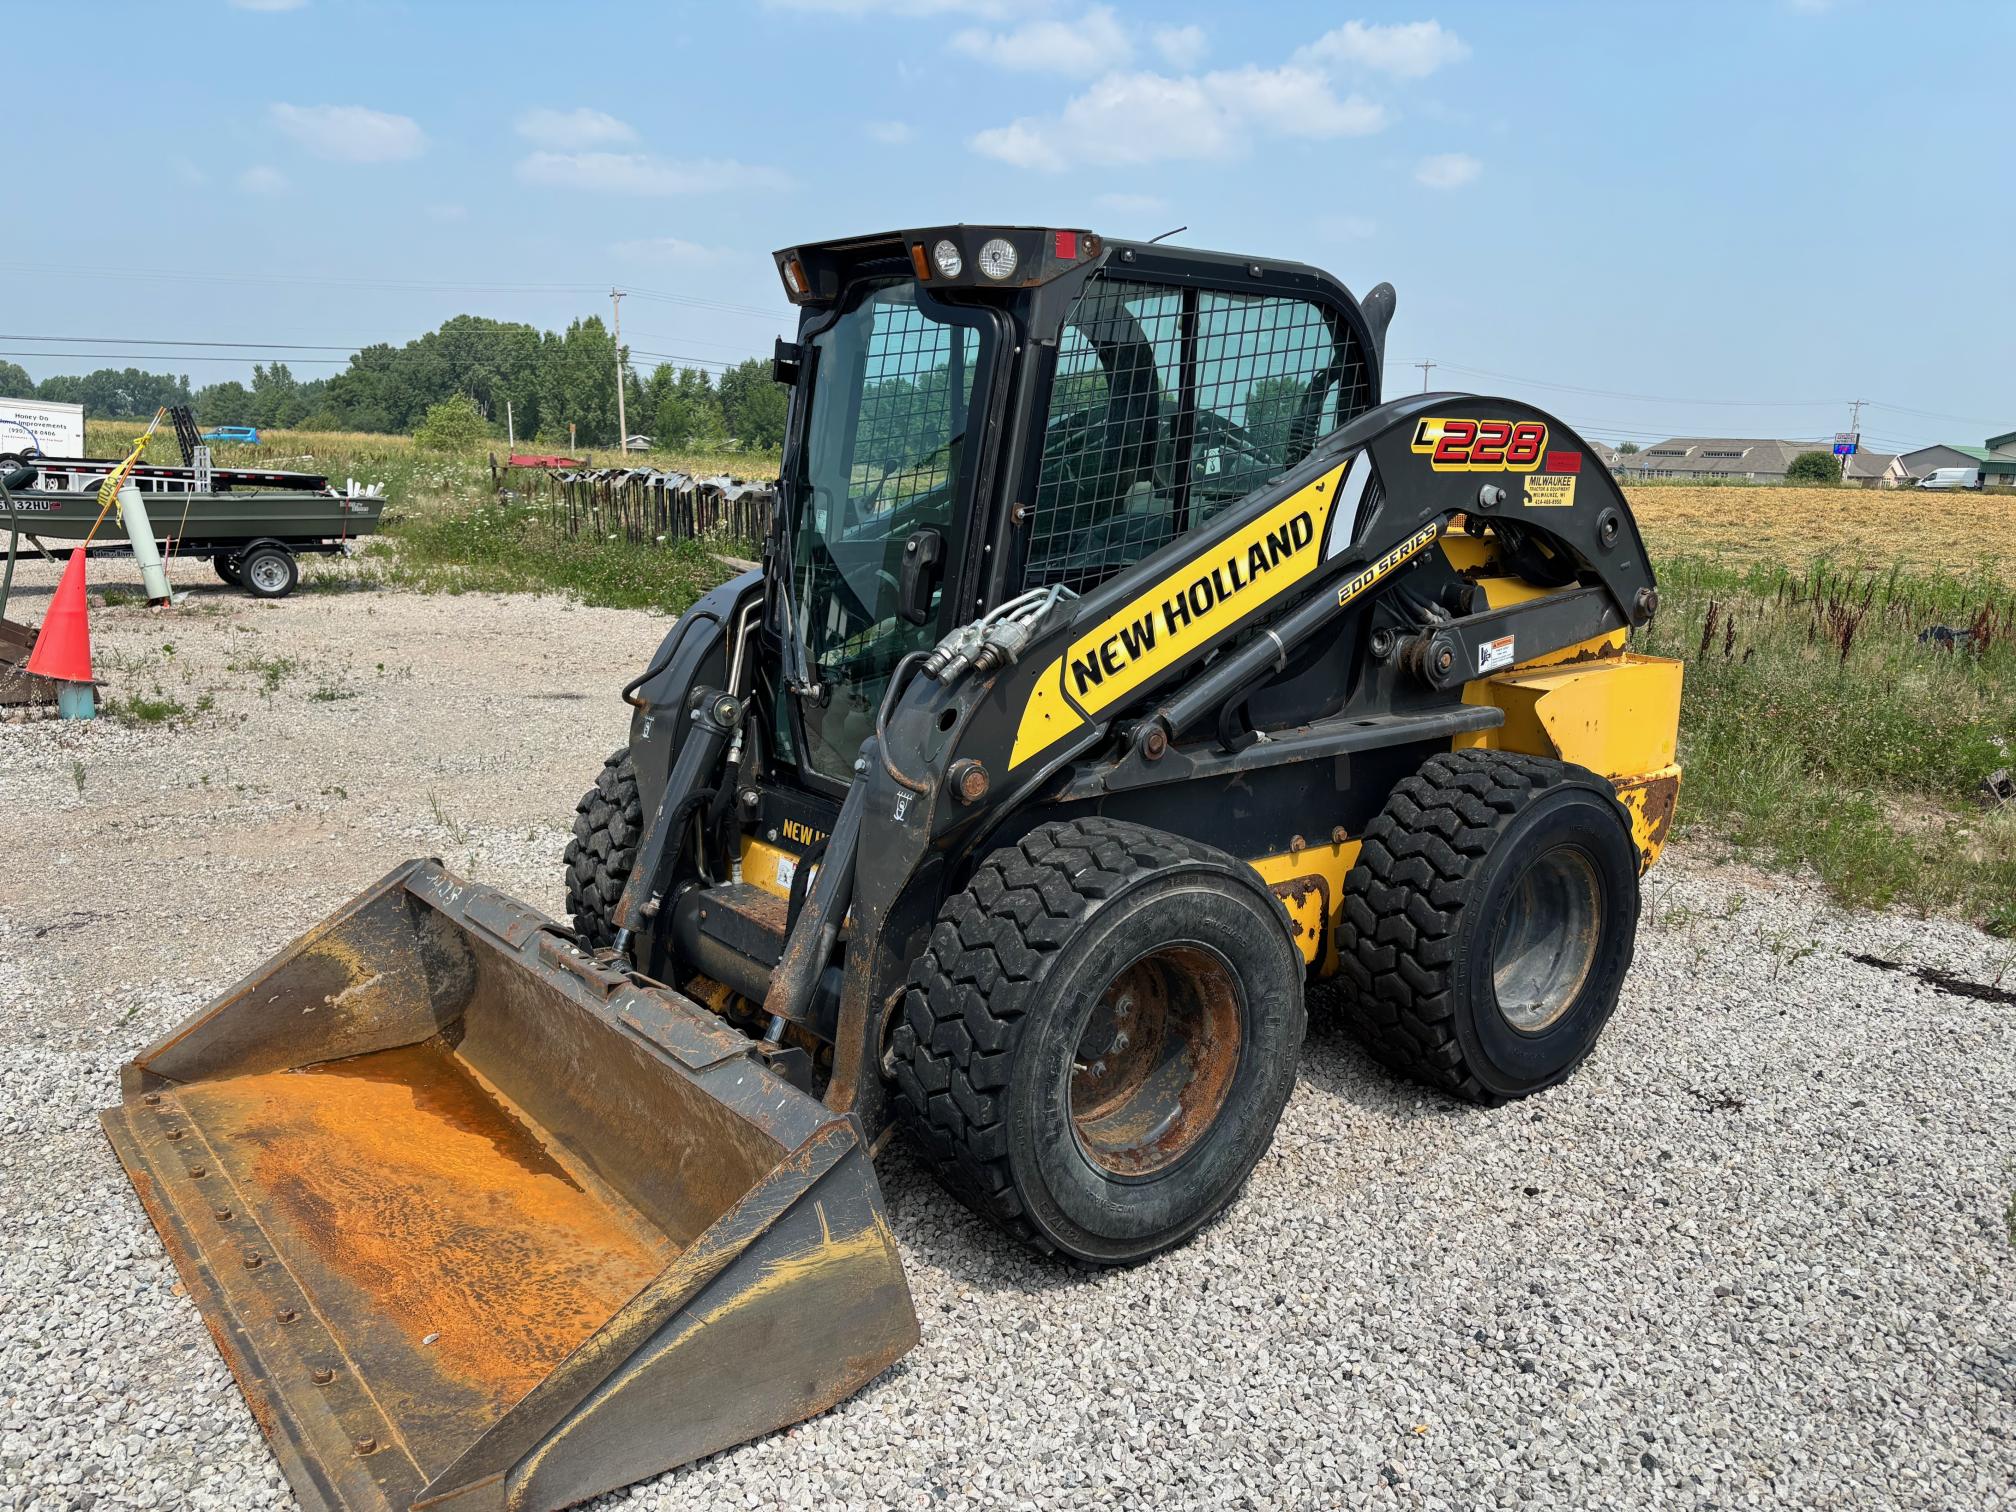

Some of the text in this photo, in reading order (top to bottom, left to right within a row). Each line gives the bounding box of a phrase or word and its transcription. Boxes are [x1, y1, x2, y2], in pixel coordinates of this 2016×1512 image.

[15, 413, 37, 421] Honey
[19, 420, 67, 429] Improvements
[1412, 418, 1547, 469] L228
[1529, 476, 1571, 486] MILWAUKEE
[1339, 523, 1436, 603] 200 SERIES
[1071, 509, 1315, 697] NEW HOLLAND
[783, 818, 813, 846] NEW
